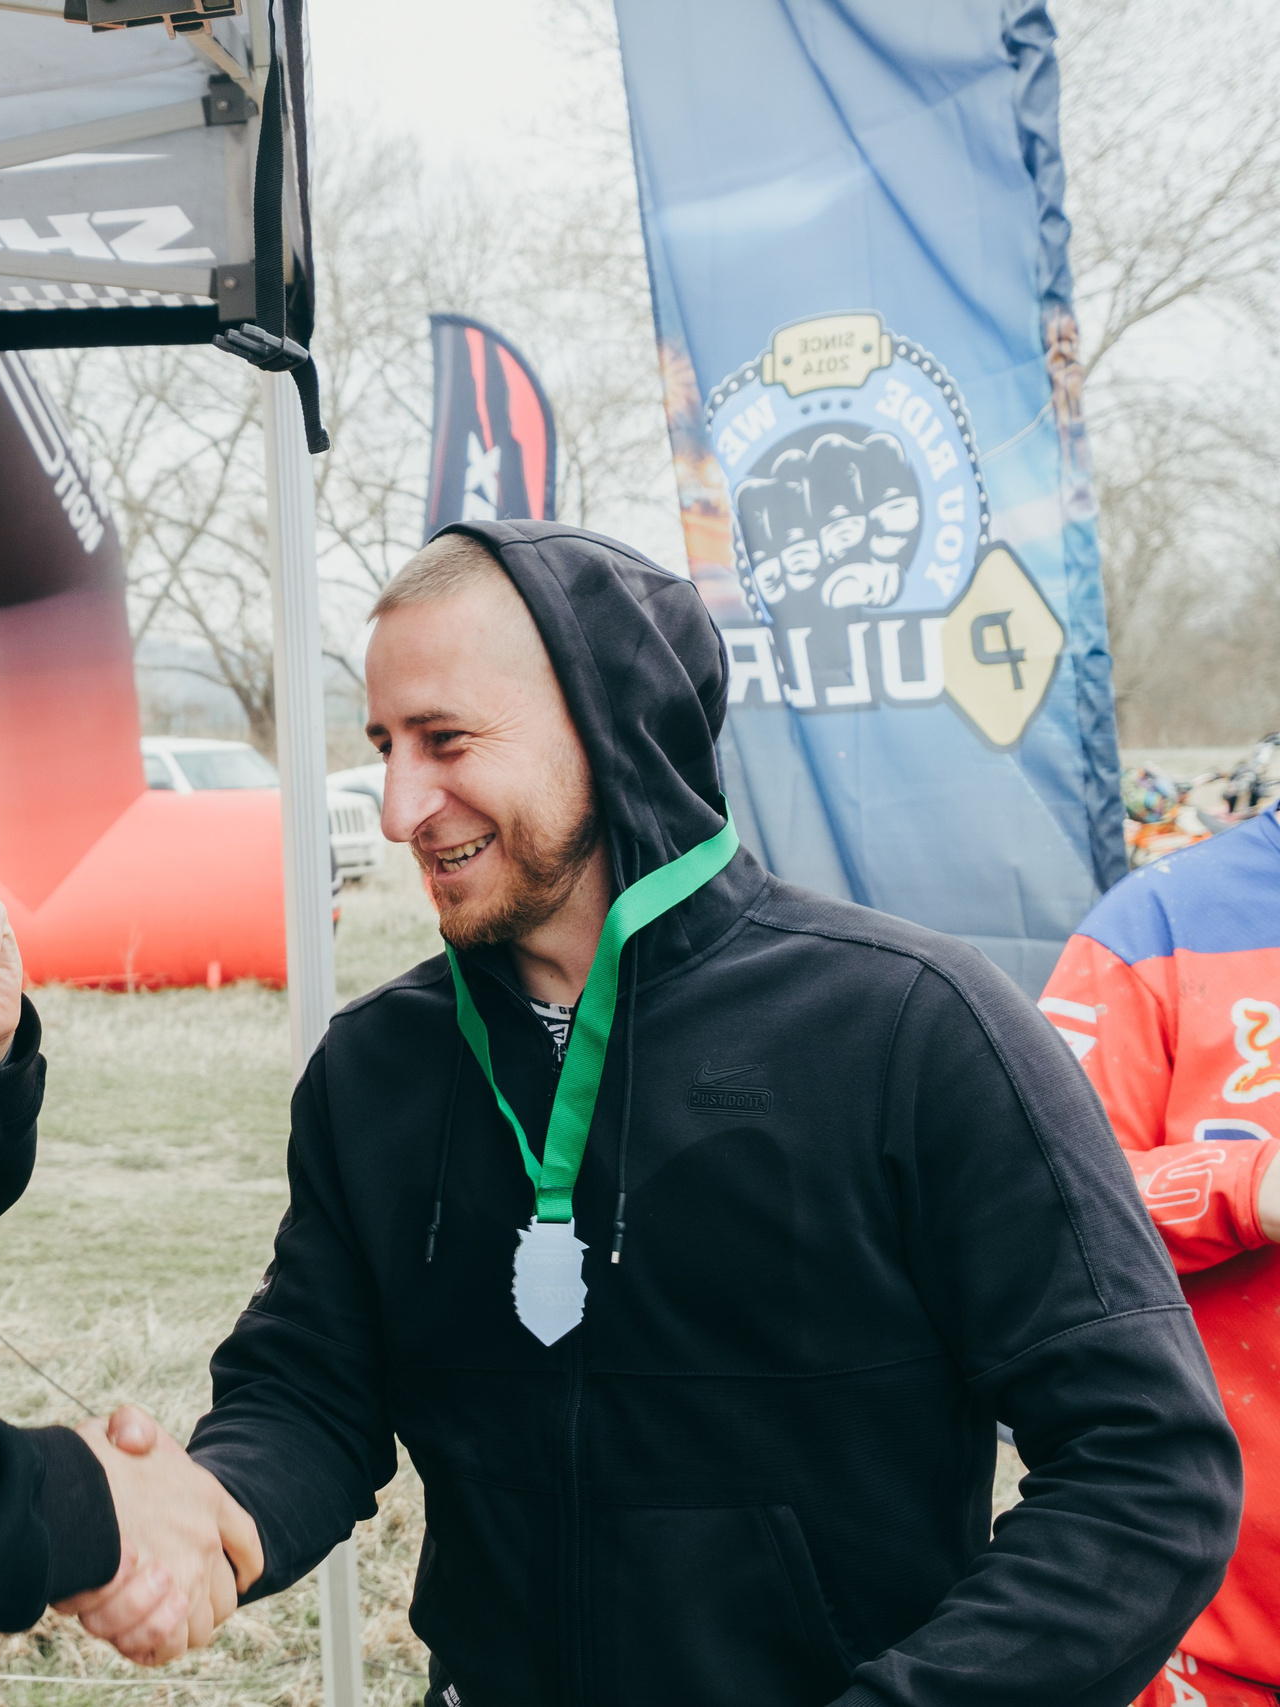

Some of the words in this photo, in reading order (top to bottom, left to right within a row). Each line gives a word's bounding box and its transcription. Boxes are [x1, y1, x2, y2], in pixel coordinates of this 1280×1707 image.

[693, 1093, 725, 1105] JUST
[728, 1095, 745, 1107] DO
[749, 1097, 764, 1108] IT.
